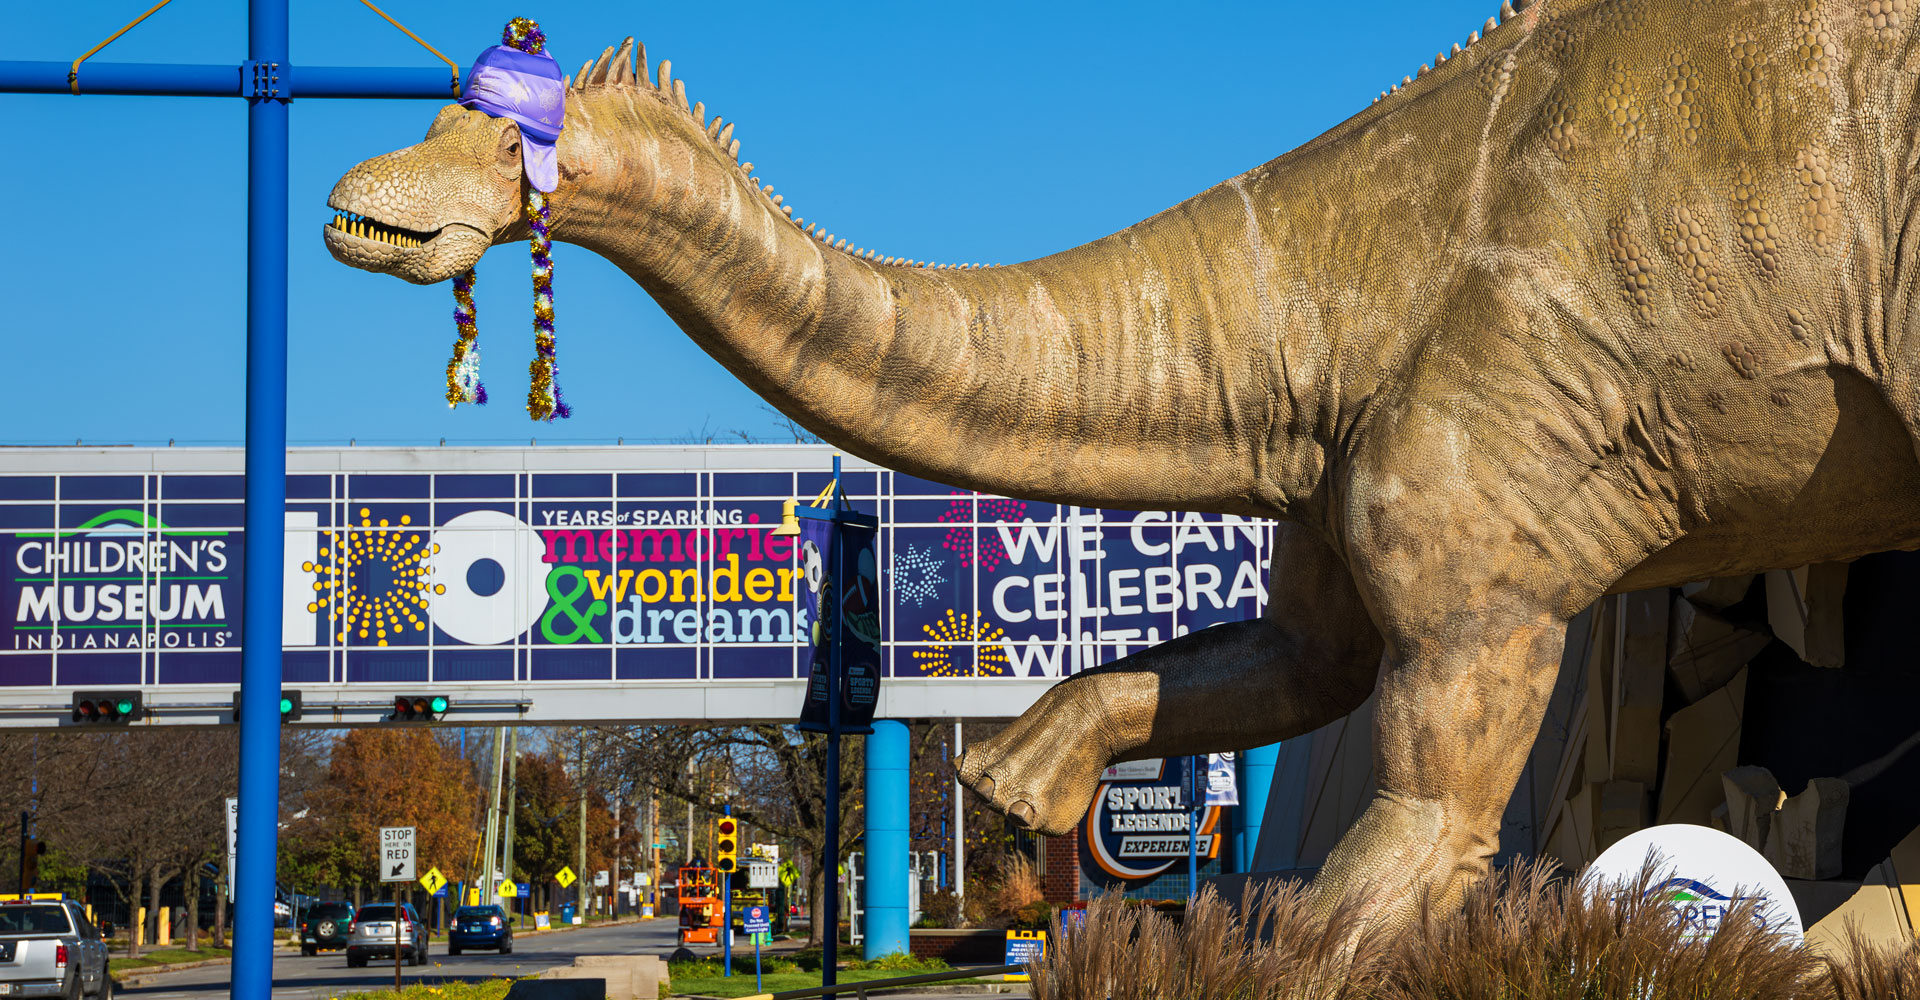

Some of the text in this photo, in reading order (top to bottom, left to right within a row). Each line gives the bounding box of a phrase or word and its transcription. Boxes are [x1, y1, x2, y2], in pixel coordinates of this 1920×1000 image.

[542, 509, 743, 526] YEARS of SPARKING
[996, 514, 1106, 565] WE
[16, 540, 228, 574] CHILDREN'S
[16, 584, 226, 622] MUSEUM
[1107, 786, 1186, 811] SPORT
[385, 830, 412, 840] STOP
[387, 849, 409, 860] RED
[1124, 840, 1208, 853] EXPERIENE
